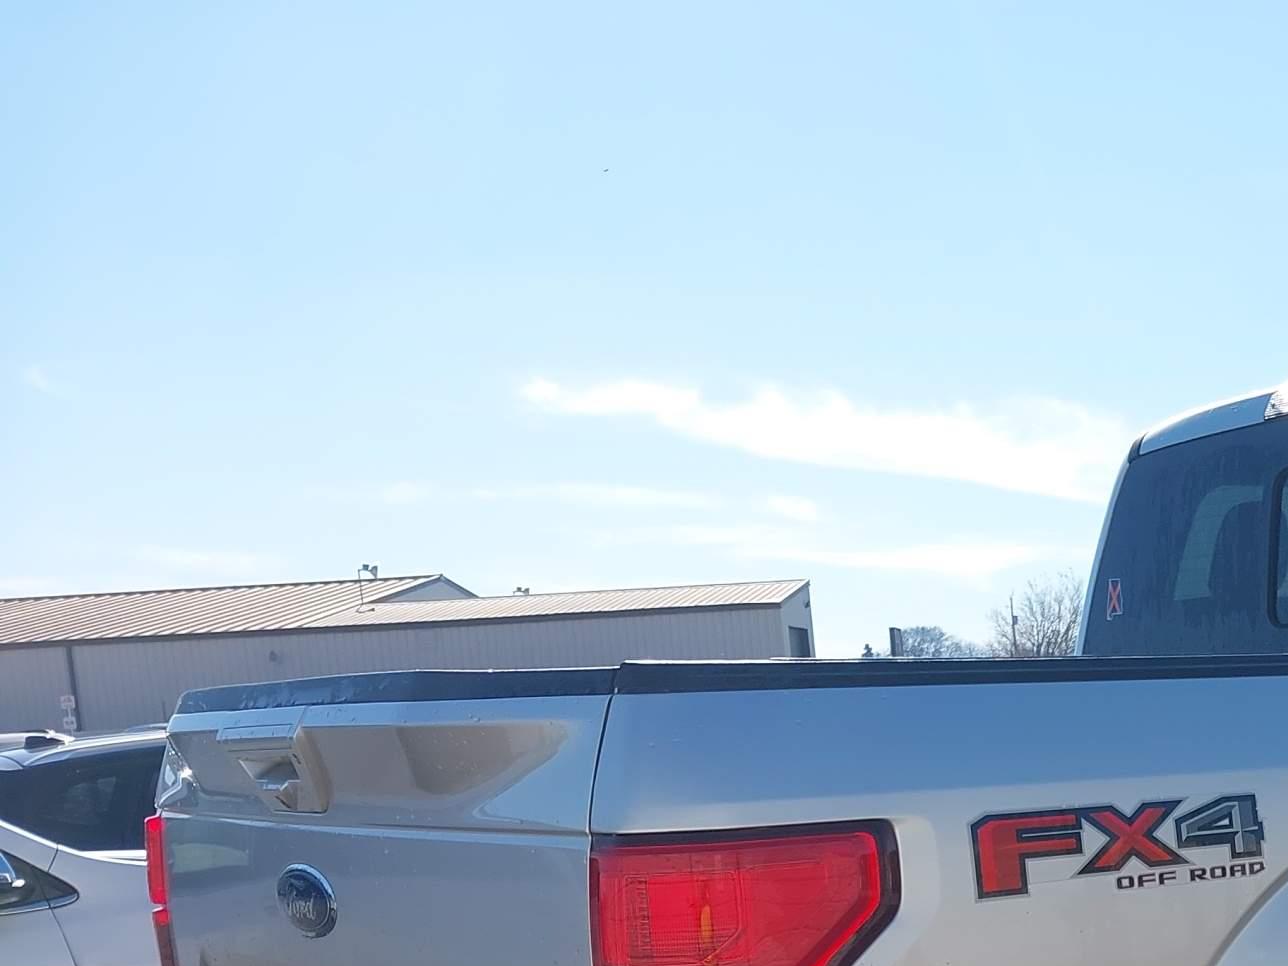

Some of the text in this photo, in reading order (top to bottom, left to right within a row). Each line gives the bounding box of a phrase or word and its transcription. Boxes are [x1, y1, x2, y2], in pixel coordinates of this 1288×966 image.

[970, 793, 1265, 899] FX4
[1116, 862, 1266, 890] OFF ROAD
